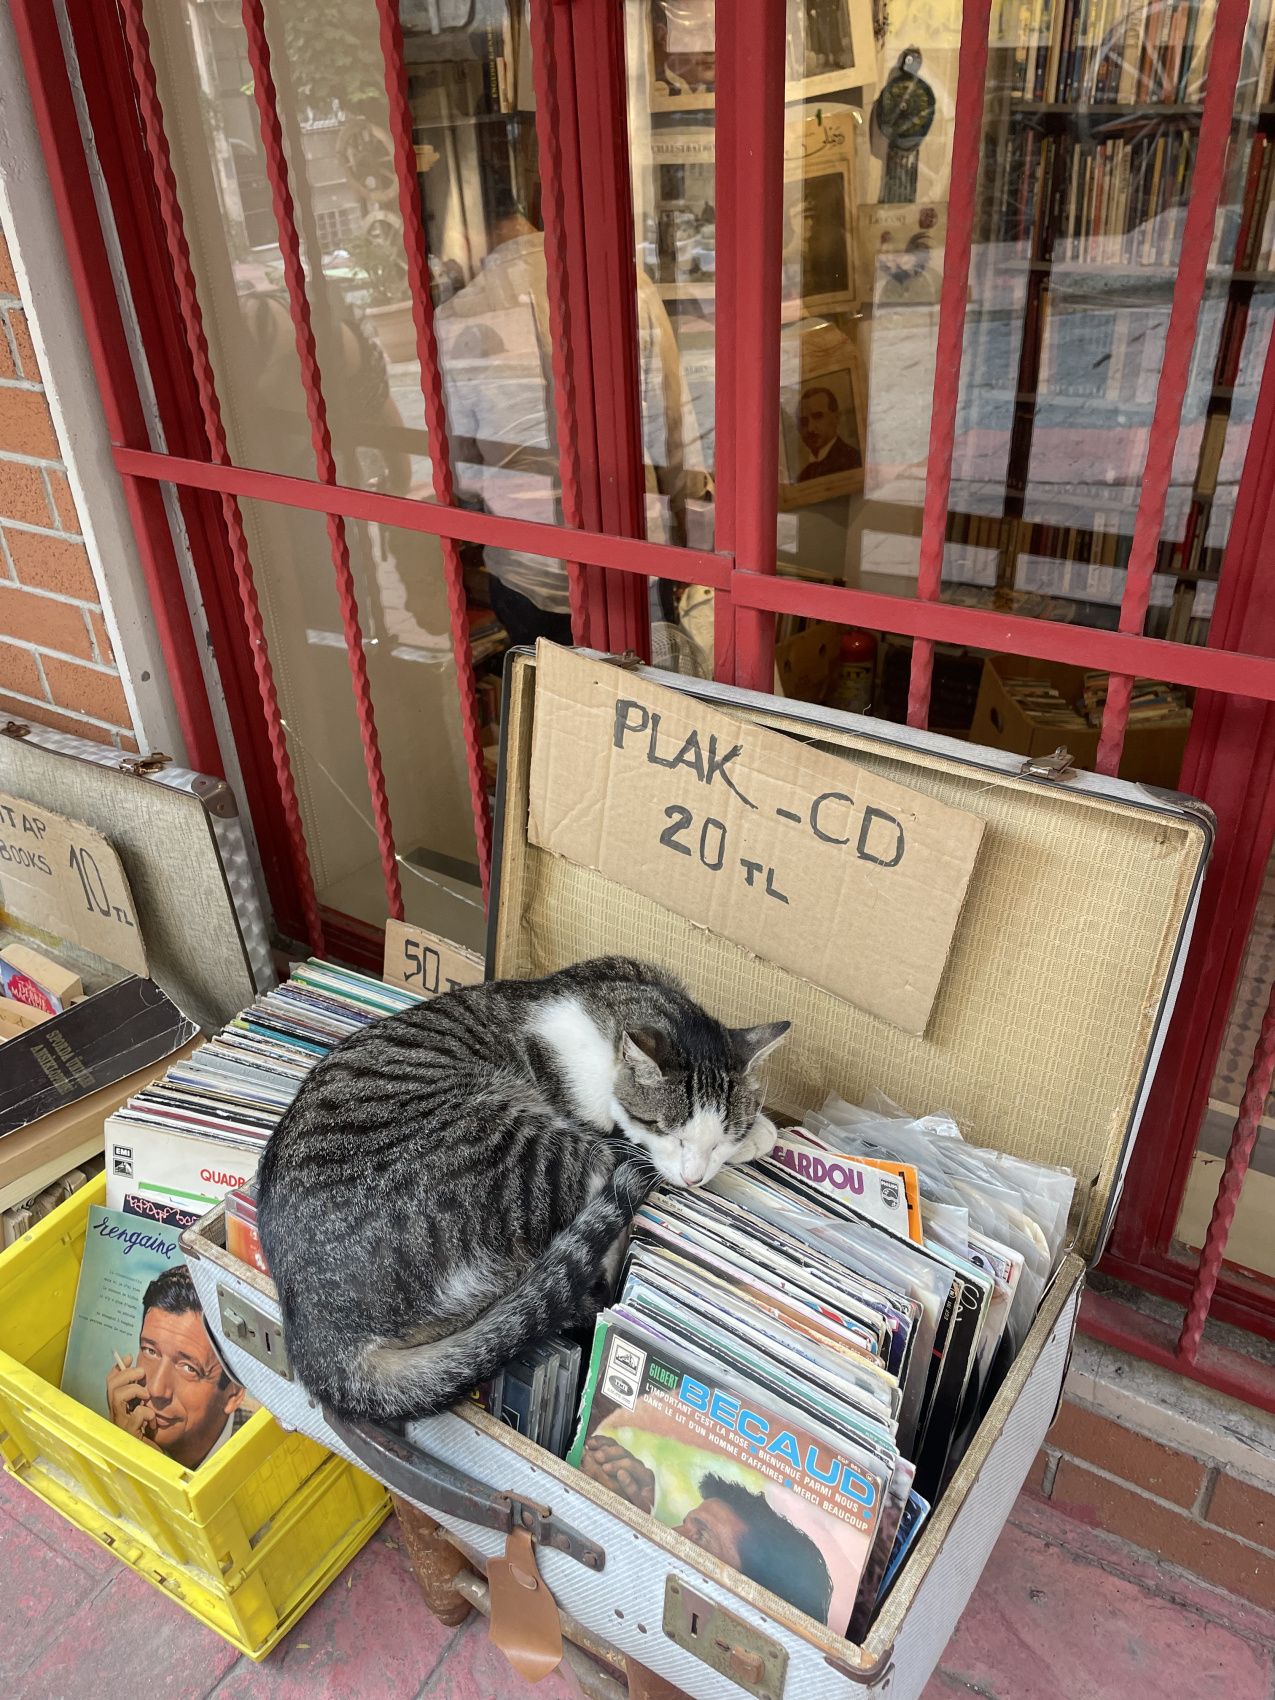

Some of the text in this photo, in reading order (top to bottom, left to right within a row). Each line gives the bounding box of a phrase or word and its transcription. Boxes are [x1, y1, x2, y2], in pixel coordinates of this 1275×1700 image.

[613, 698, 759, 809] PLAK
[69, 844, 134, 927] 10 TL
[659, 805, 790, 905] 20 TL
[404, 939, 464, 995] 50 T
[115, 1146, 131, 1158] EMI
[93, 1216, 178, 1260] rengaine
[649, 1362, 679, 1390] GILBERT
[643, 1393, 662, 1410] DANS
[665, 1407, 673, 1417] LE
[675, 1413, 686, 1424] LIT
[688, 1421, 706, 1437] D'UN
[708, 1433, 738, 1457] HOMME
[741, 1452, 784, 1483] D'AFFAIRES
[793, 1484, 819, 1505] MERCI
[822, 1501, 869, 1531] BEAUCOUP
[645, 1382, 693, 1415] L'IMPORTANT
[694, 1412, 714, 1429] C'EST
[716, 1425, 726, 1436] LA
[729, 1432, 749, 1450] ROSE
[758, 1450, 801, 1481] BIENVENUE
[803, 1476, 832, 1498] PARMI
[834, 1494, 859, 1513] NOUS
